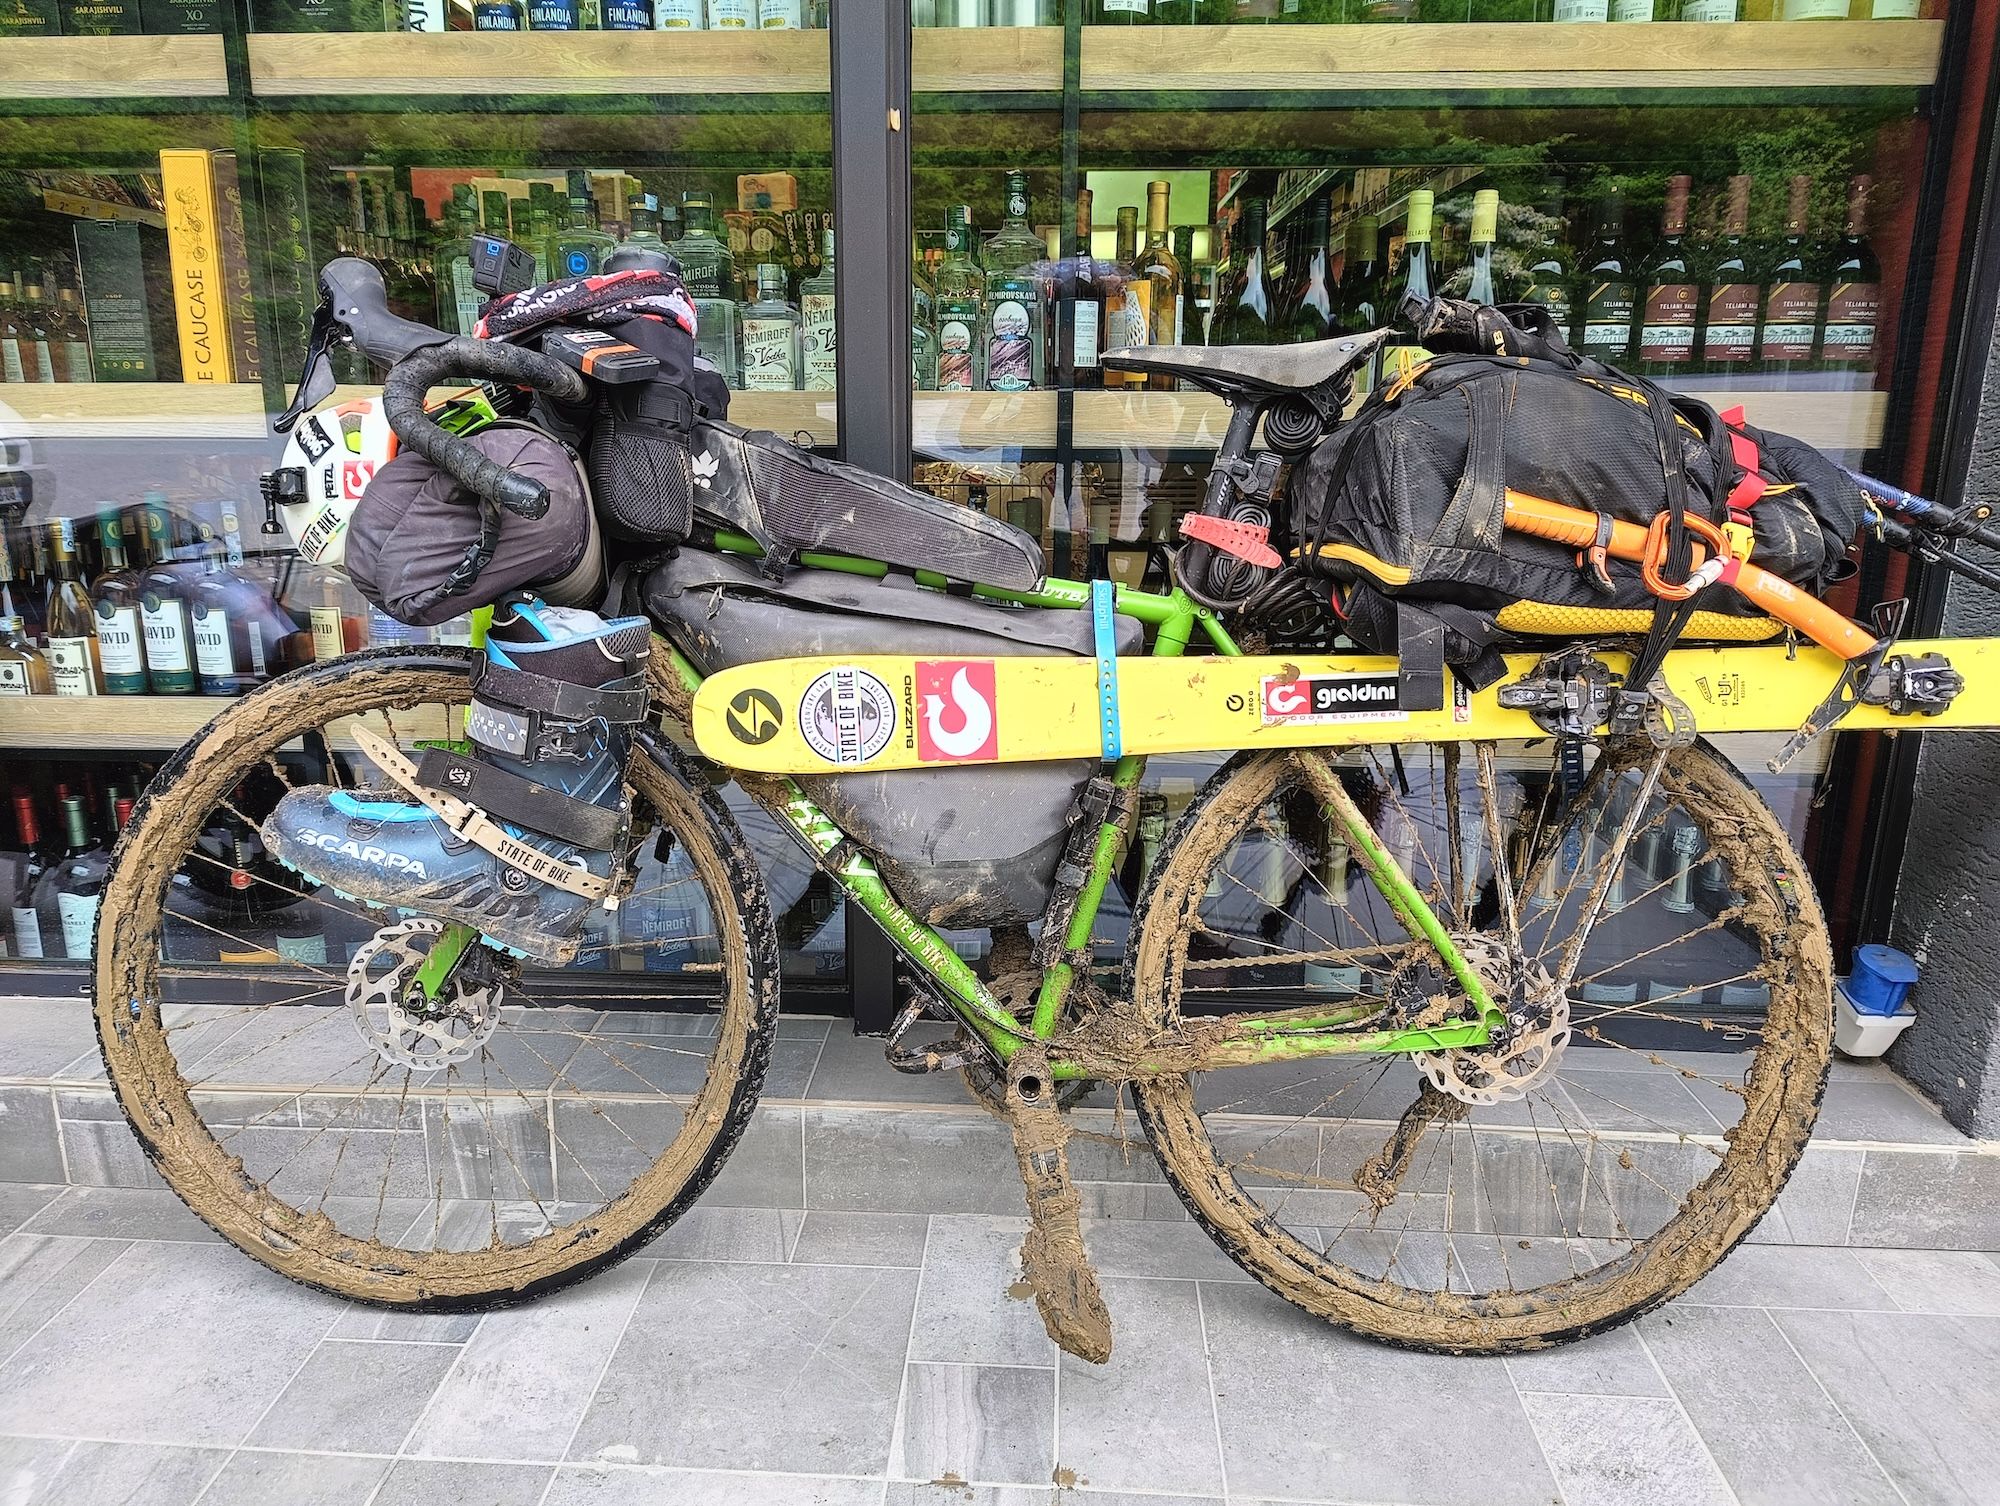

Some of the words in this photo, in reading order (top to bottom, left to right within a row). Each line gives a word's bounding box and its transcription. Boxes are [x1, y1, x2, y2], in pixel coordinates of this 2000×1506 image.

[75, 6, 124, 15] SARAJISHVILI
[185, 9, 203, 21] XO
[530, 7, 573, 25] FINLANDIA
[608, 7, 650, 26] FINLANDIA
[186, 269, 212, 364] CAUCASE
[744, 327, 790, 345] NEMIROFF
[754, 347, 787, 367] Vodka
[324, 462, 339, 500] PETZL
[312, 526, 324, 545] OF
[320, 507, 342, 535] BIKE
[837, 671, 854, 699] BIKE
[1315, 683, 1396, 709] gialdini
[838, 705, 855, 719] OF
[904, 675, 914, 749] BLIZZARD
[1332, 711, 1404, 720] EQUIPMENT
[841, 723, 858, 762] STATE
[296, 828, 428, 880] SCARPA
[497, 839, 534, 867] STATE
[532, 858, 549, 877] OF
[547, 865, 572, 884] BIKE
[642, 916, 692, 934] NEMIROFF
[879, 898, 915, 933] STATE
[908, 927, 925, 947] OF
[921, 937, 948, 972] BIKE
[576, 949, 602, 965] Vodka
